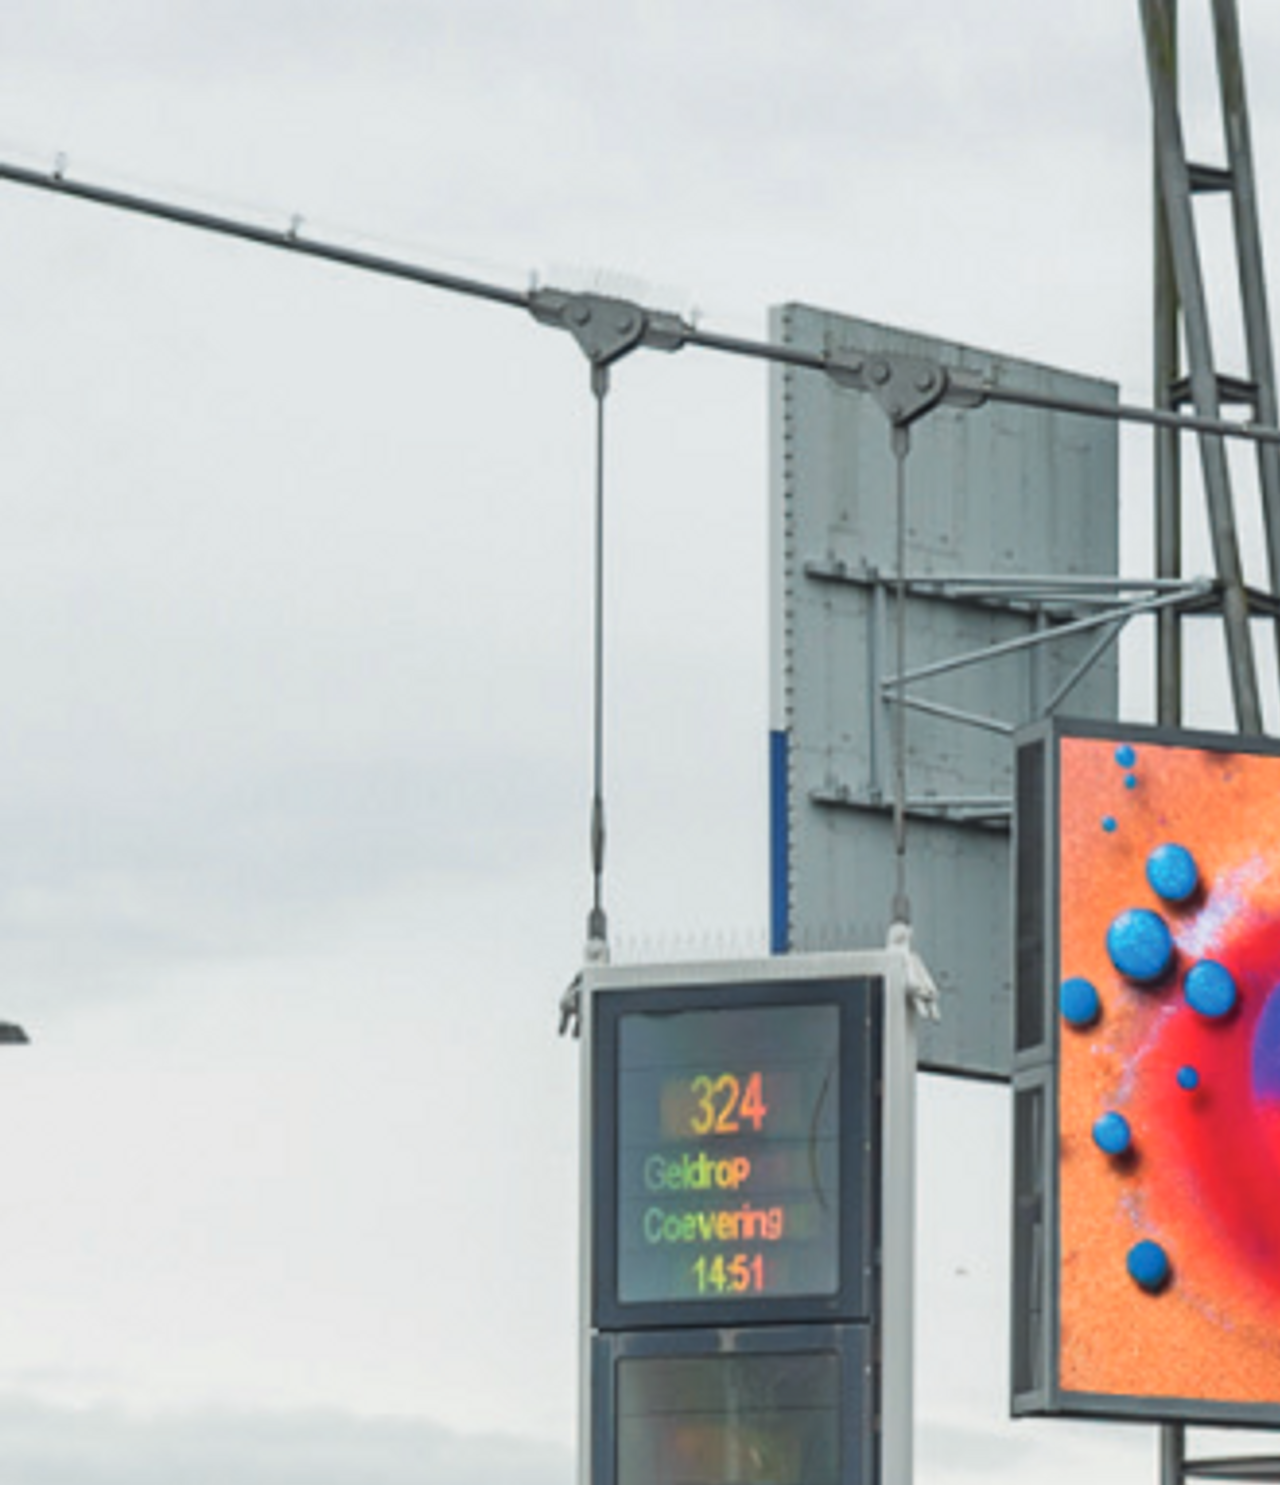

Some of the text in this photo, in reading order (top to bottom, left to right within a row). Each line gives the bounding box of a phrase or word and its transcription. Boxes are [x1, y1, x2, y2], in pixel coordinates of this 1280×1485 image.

[690, 1072, 767, 1134] 324
[644, 1153, 750, 1190] Geldrop
[644, 1204, 784, 1243] Coevering
[692, 1254, 765, 1294] 14:51
